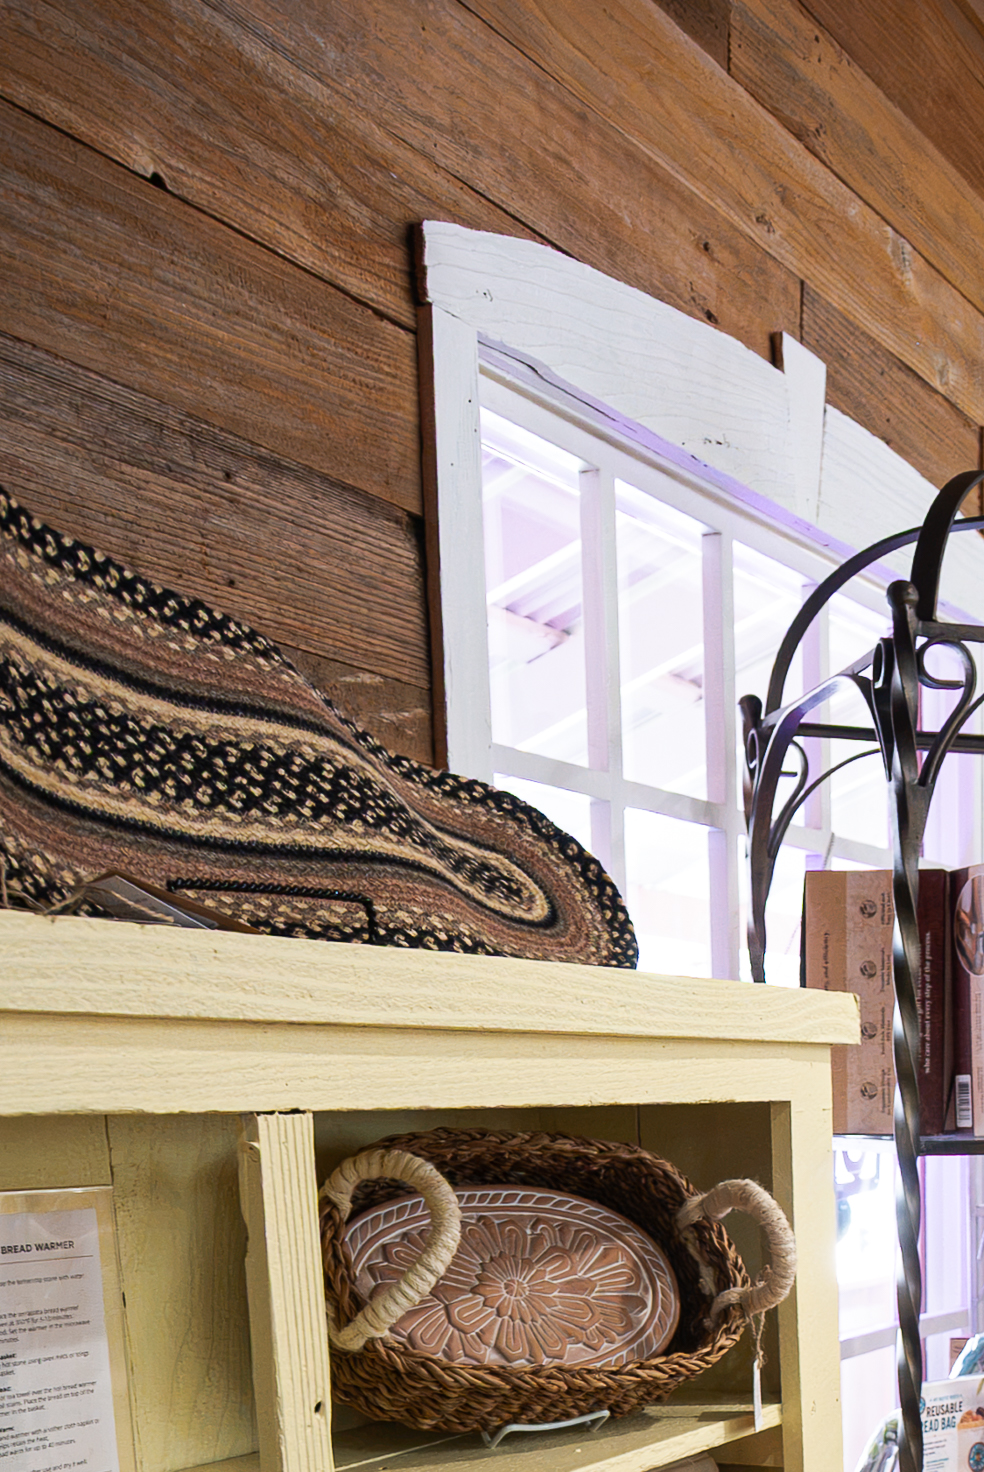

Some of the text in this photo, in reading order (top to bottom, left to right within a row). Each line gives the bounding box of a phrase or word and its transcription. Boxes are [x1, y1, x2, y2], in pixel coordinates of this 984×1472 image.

[0, 1240, 75, 1254] BREAD WARMER
[926, 1401, 963, 1417] REUSABLE
[924, 1416, 957, 1432] EAD BAG
